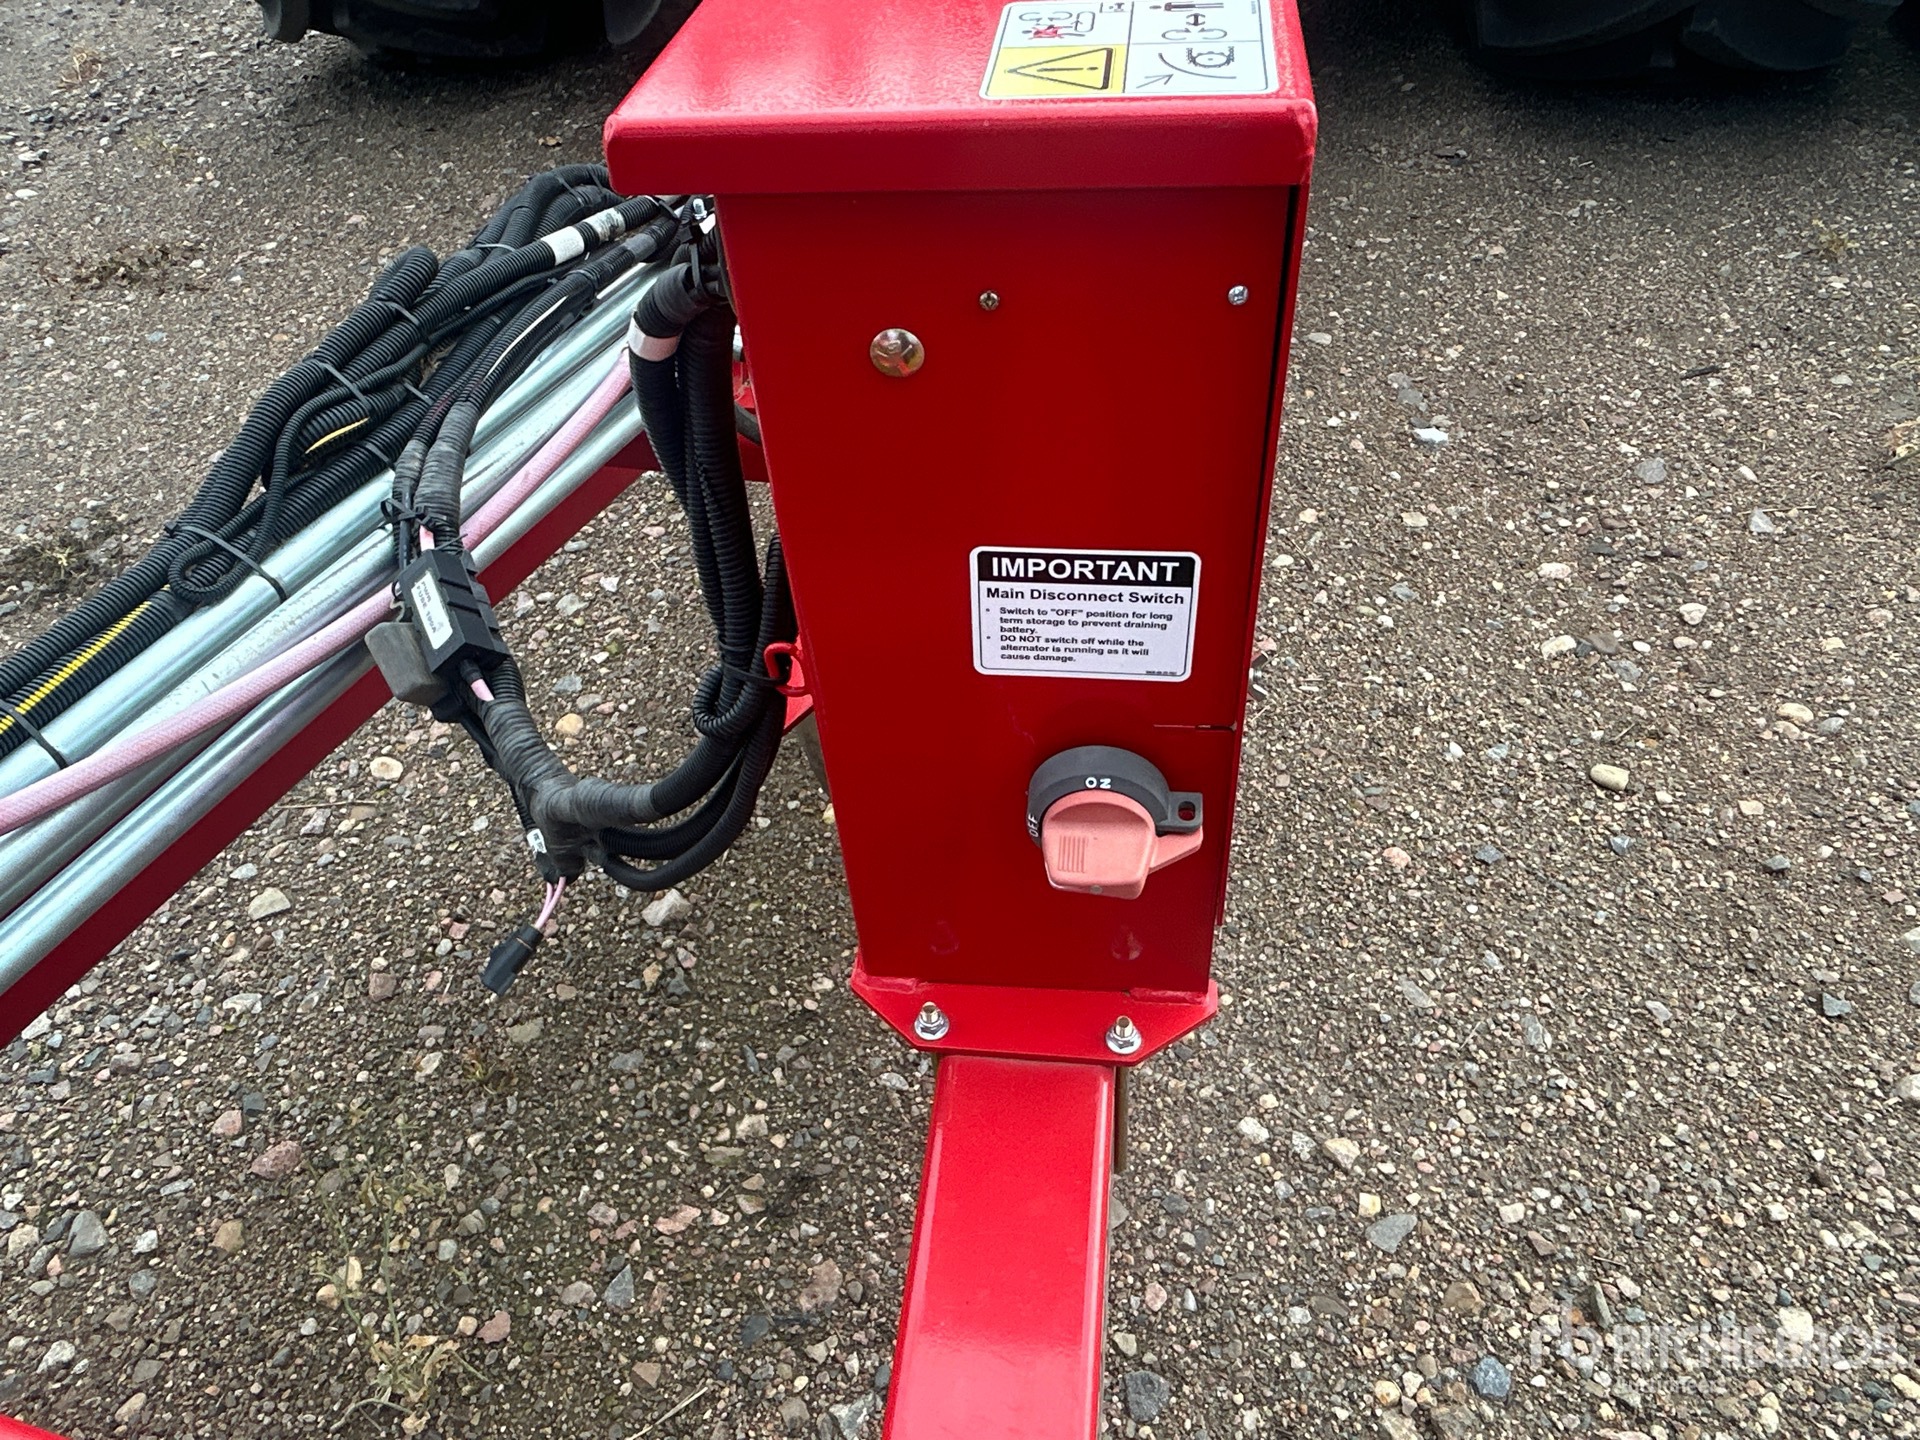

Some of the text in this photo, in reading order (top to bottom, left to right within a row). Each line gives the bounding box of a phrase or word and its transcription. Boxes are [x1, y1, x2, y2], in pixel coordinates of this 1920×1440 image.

[992, 557, 1180, 582] IMPORTANT
[416, 586, 428, 611] FUSE
[986, 588, 1184, 605] Main Disconnect Switch
[1000, 607, 1173, 621] Switch to "OFF" position for long
[1000, 626, 1038, 635] battery.
[1026, 618, 1065, 627] storage
[1081, 619, 1121, 628] prevent
[1123, 621, 1167, 630] draining
[1019, 635, 1042, 643] NOT
[1080, 637, 1096, 645] off
[1097, 637, 1125, 646] while
[1000, 644, 1049, 652] alternator
[1052, 645, 1061, 653] is
[1064, 646, 1104, 655] running
[1131, 648, 1149, 656] will
[1000, 653, 1076, 663] cause damage.
[1085, 776, 1112, 789] ON
[1028, 813, 1038, 838] OFF
